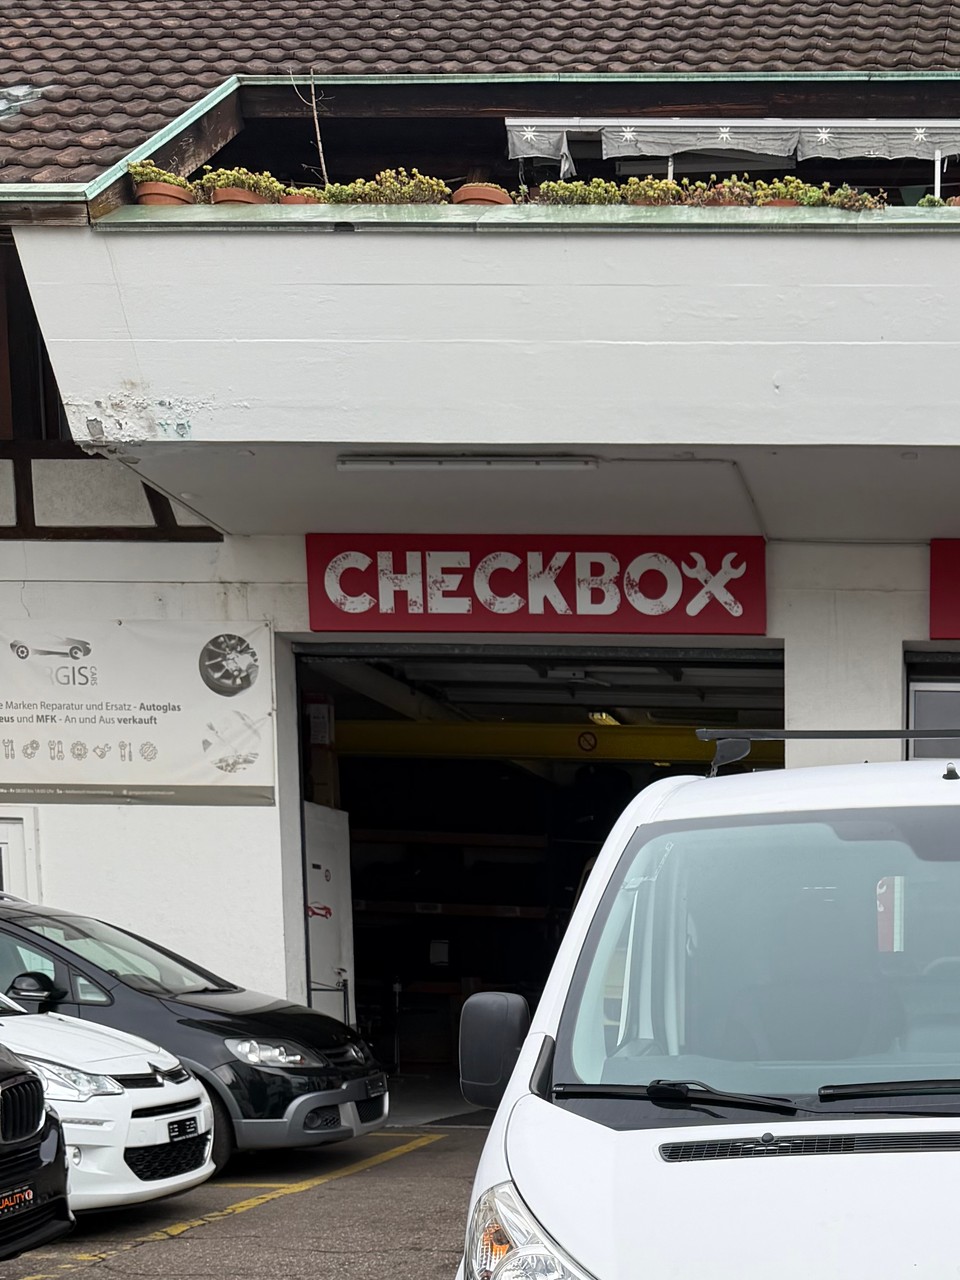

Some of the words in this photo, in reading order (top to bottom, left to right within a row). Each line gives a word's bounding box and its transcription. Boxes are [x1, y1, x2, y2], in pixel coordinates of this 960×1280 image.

[324, 550, 747, 617] CHECKBOX
[5, 701, 38, 710] Marken
[40, 701, 84, 712] Reparatur
[86, 702, 103, 711] und
[105, 702, 132, 711] Ersatz
[139, 702, 181, 712] Autoglas
[16, 715, 34, 724] und
[36, 715, 57, 724] MFK
[64, 715, 77, 724] An
[78, 715, 96, 724] und
[99, 715, 116, 724] Aus
[117, 715, 158, 725] verkauft
